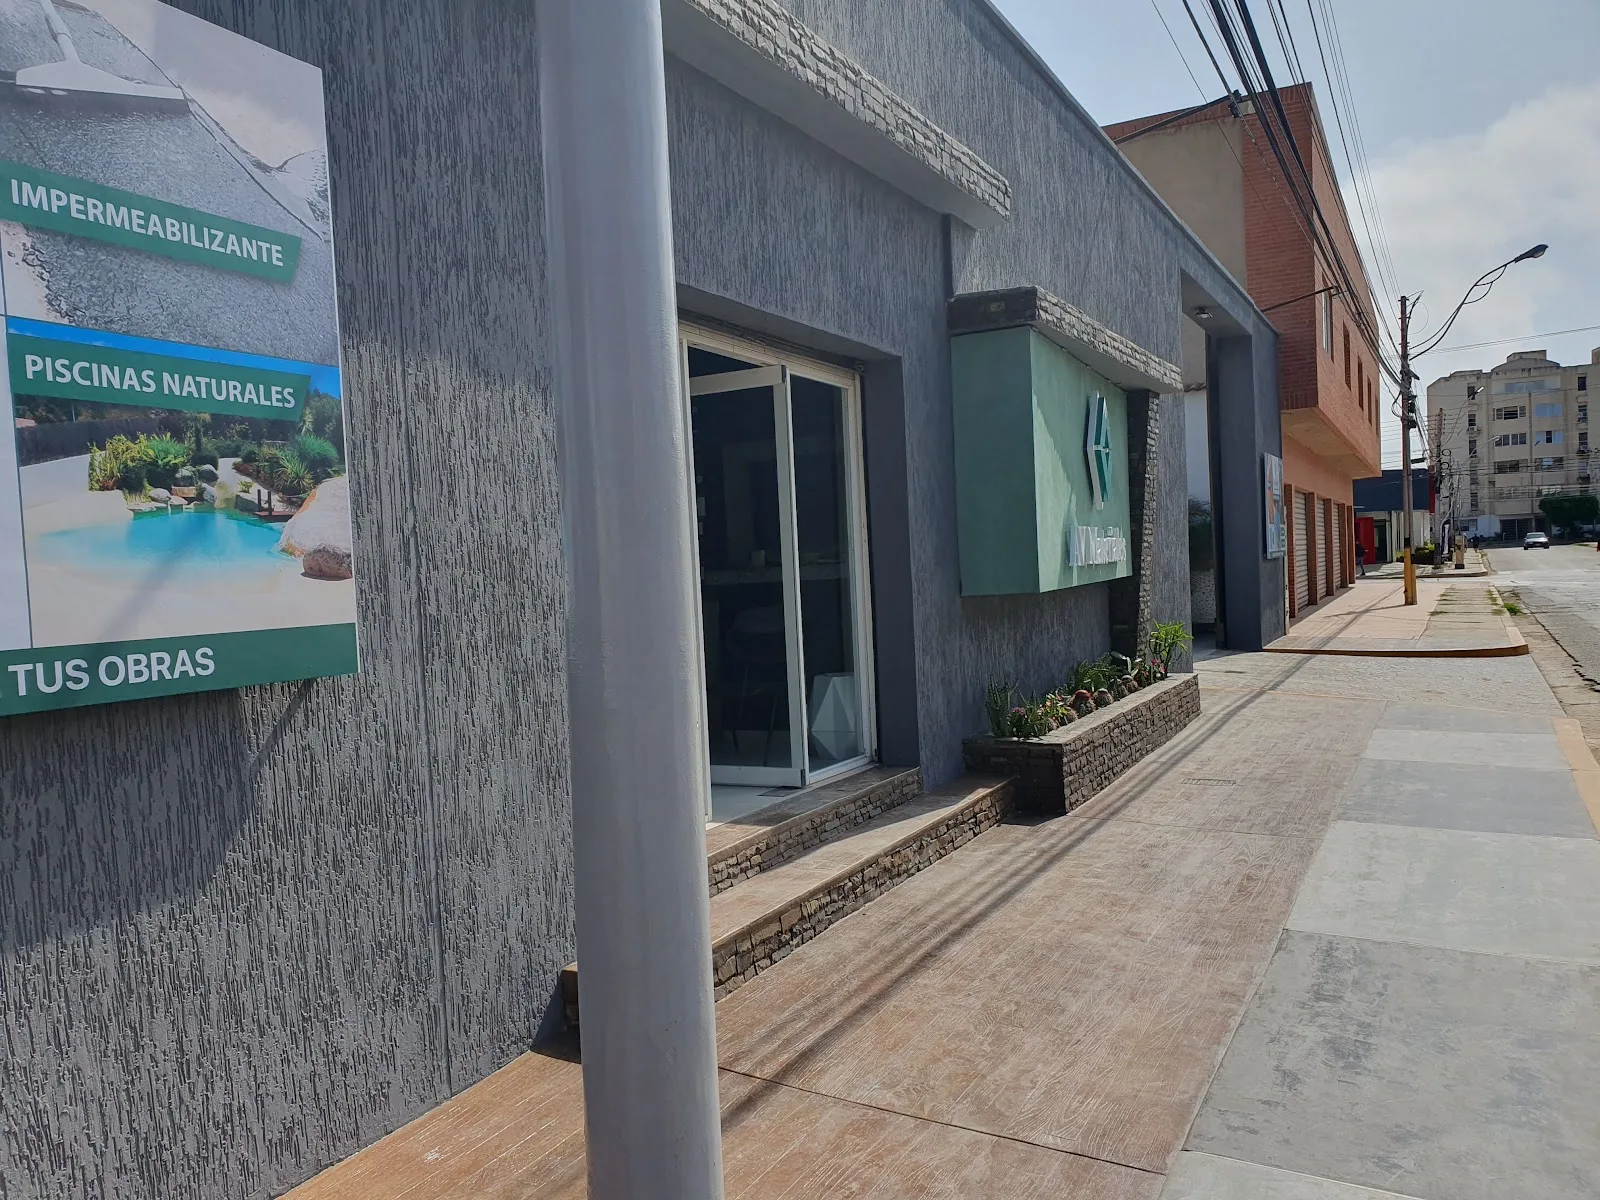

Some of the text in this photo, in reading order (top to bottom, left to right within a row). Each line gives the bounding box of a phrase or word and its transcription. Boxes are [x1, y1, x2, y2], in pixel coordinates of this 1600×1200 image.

[11, 179, 284, 267] IMPERMEABILIZANTE
[25, 354, 295, 409] PISCINAS NATURALES
[8, 647, 215, 696] TUS OBRAS
